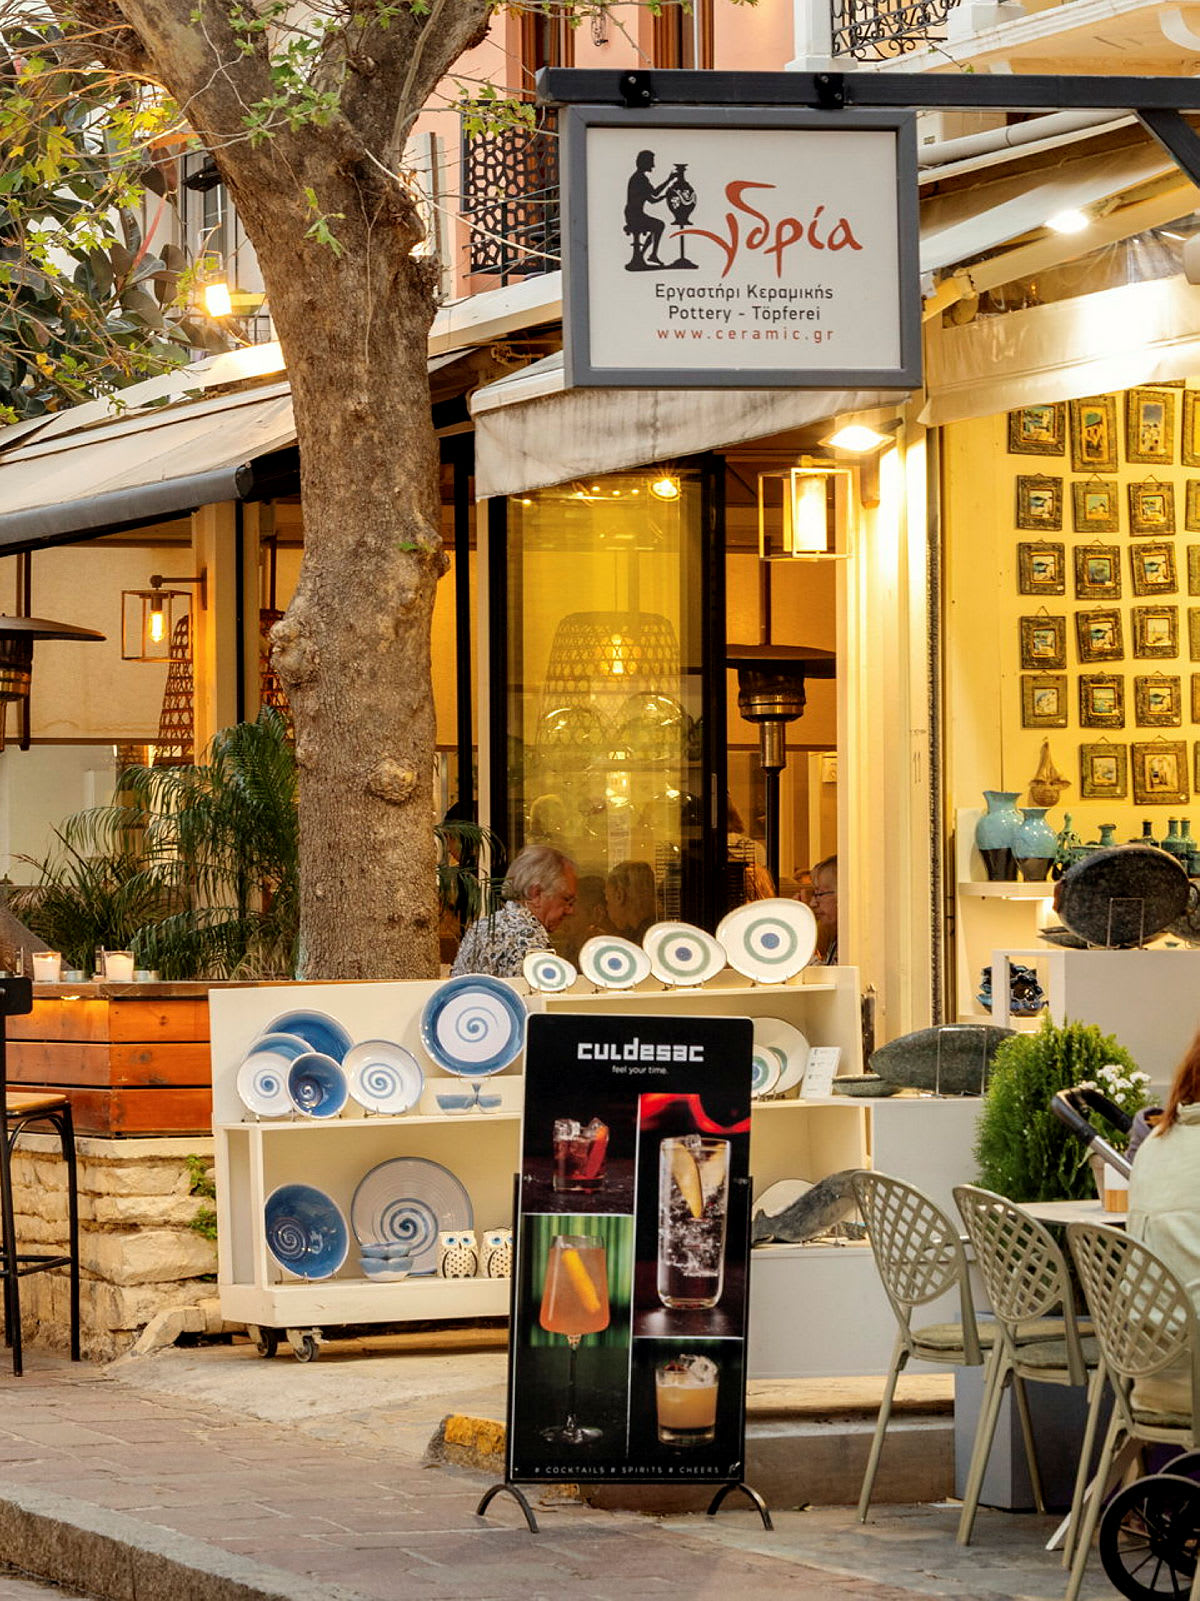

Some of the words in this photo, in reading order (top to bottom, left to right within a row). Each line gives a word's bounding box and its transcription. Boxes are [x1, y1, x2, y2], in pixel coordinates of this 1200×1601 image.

[655, 282, 740, 302] Εργαστήρι
[747, 283, 834, 302] Κεραμικής
[669, 305, 732, 322] Pottery
[752, 305, 821, 322] Töpferei
[656, 327, 835, 344] www.ceramic.gr
[612, 1065, 627, 1074] feel
[628, 1066, 647, 1075] your
[545, 1466, 605, 1474] COCKTAILS
[621, 1466, 663, 1474] SPIRITS
[679, 1466, 719, 1474] CHEERS
